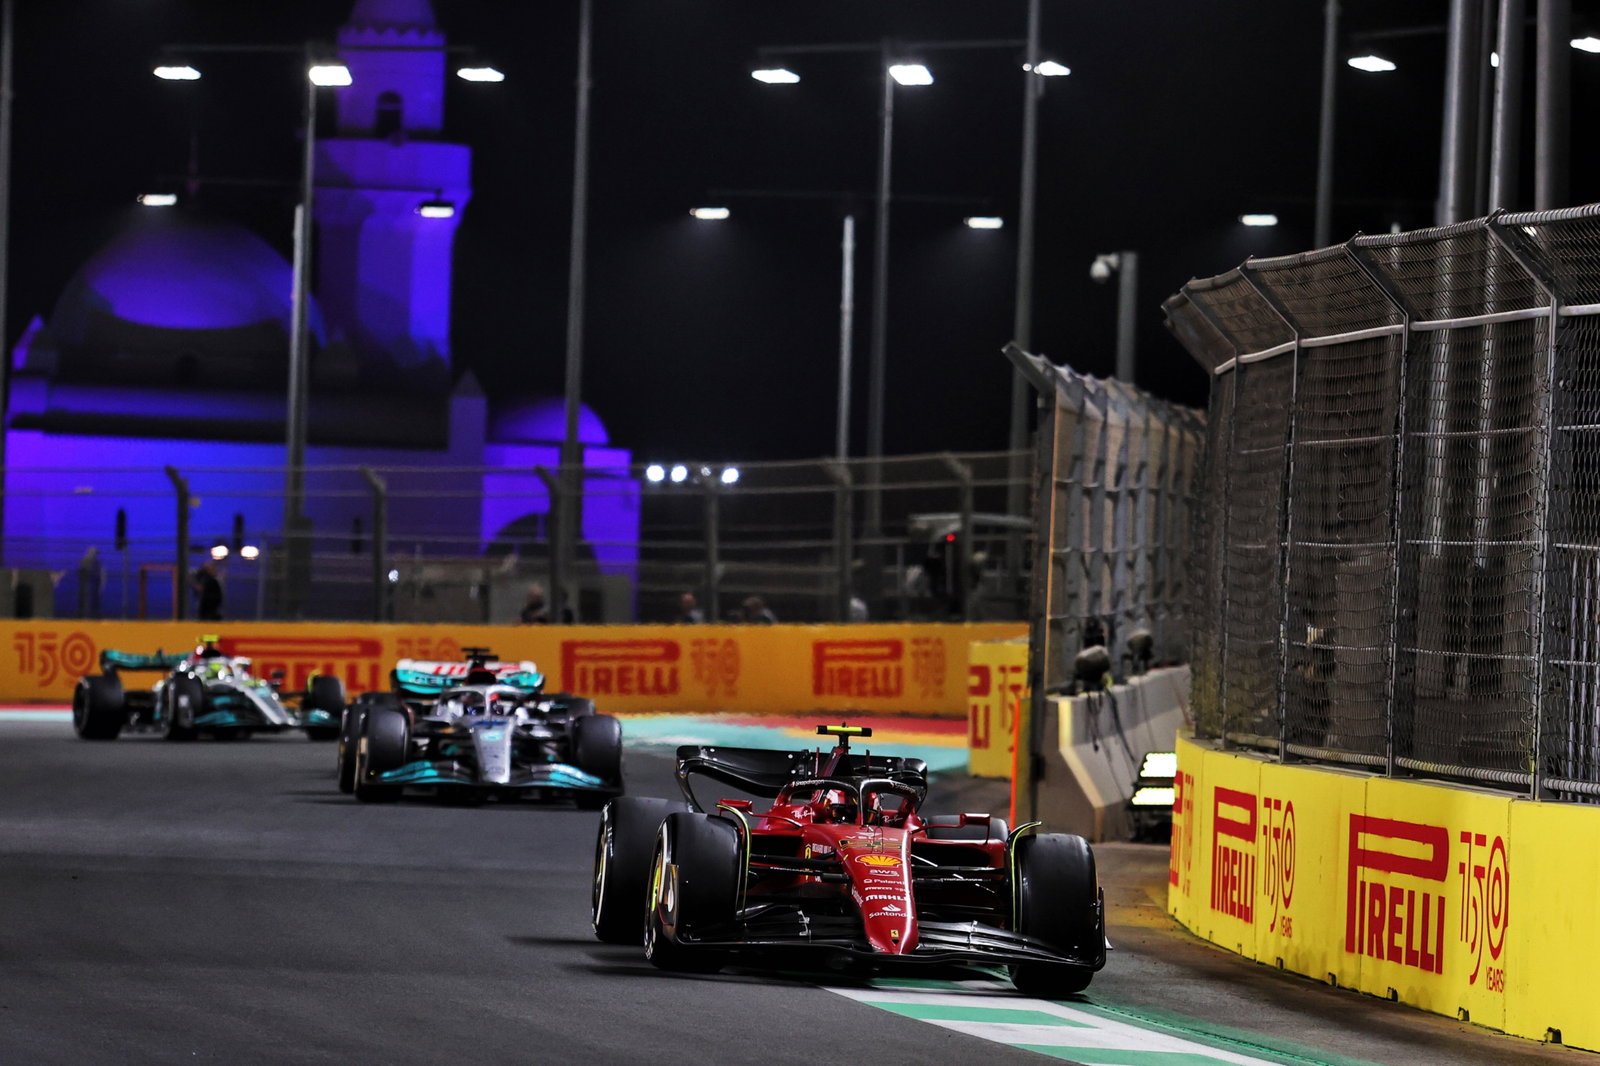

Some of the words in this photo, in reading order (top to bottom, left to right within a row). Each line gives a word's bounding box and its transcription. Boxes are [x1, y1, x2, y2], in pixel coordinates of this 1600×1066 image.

[14, 632, 96, 687] 150
[561, 640, 682, 695] PIRELLI
[813, 640, 904, 697] PIRELLI
[1210, 786, 1257, 924] PIRELLI
[1345, 813, 1449, 975] PIRELLI
[1459, 831, 1509, 985] 150
[1486, 966, 1504, 993] YEARS
